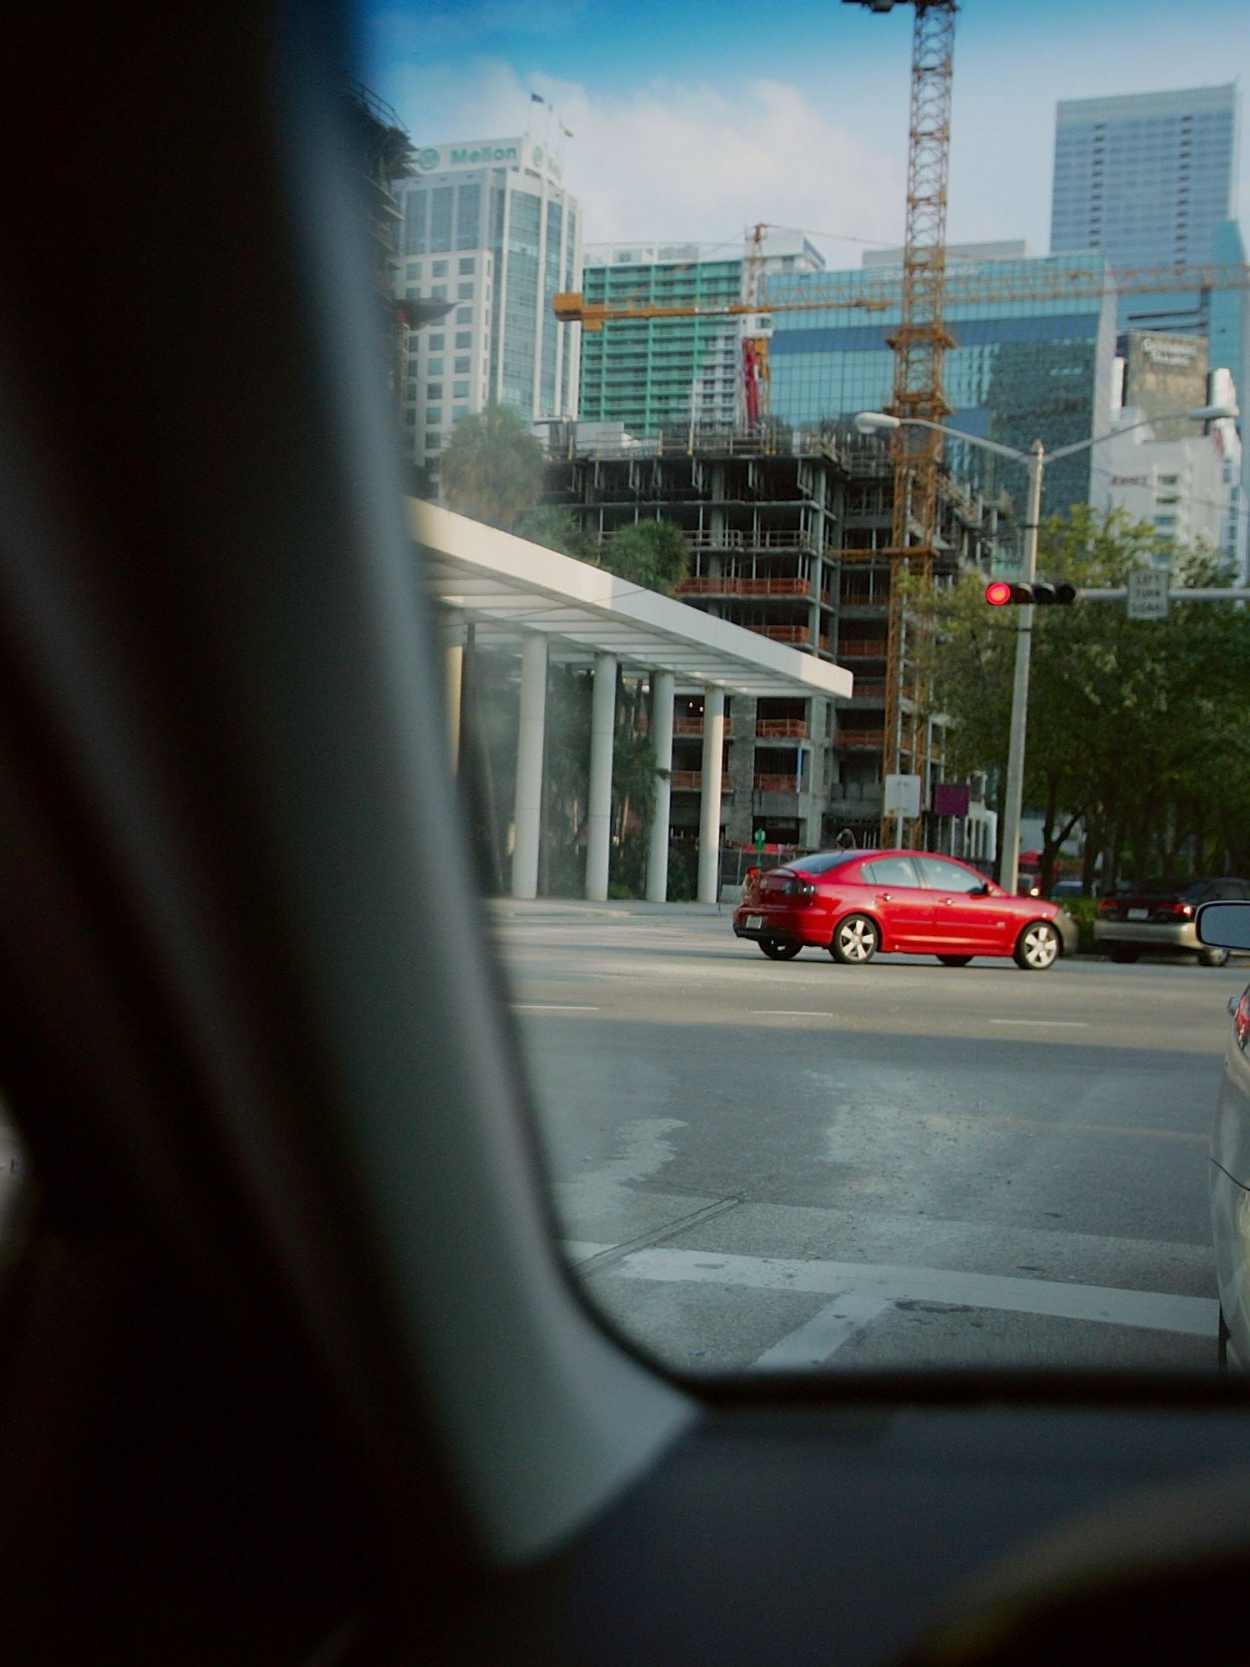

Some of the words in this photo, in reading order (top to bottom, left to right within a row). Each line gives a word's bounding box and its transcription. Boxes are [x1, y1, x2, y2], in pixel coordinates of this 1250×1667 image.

[451, 147, 517, 164] Mellon
[1136, 574, 1160, 585] LEFT
[1134, 589, 1161, 599] TURN
